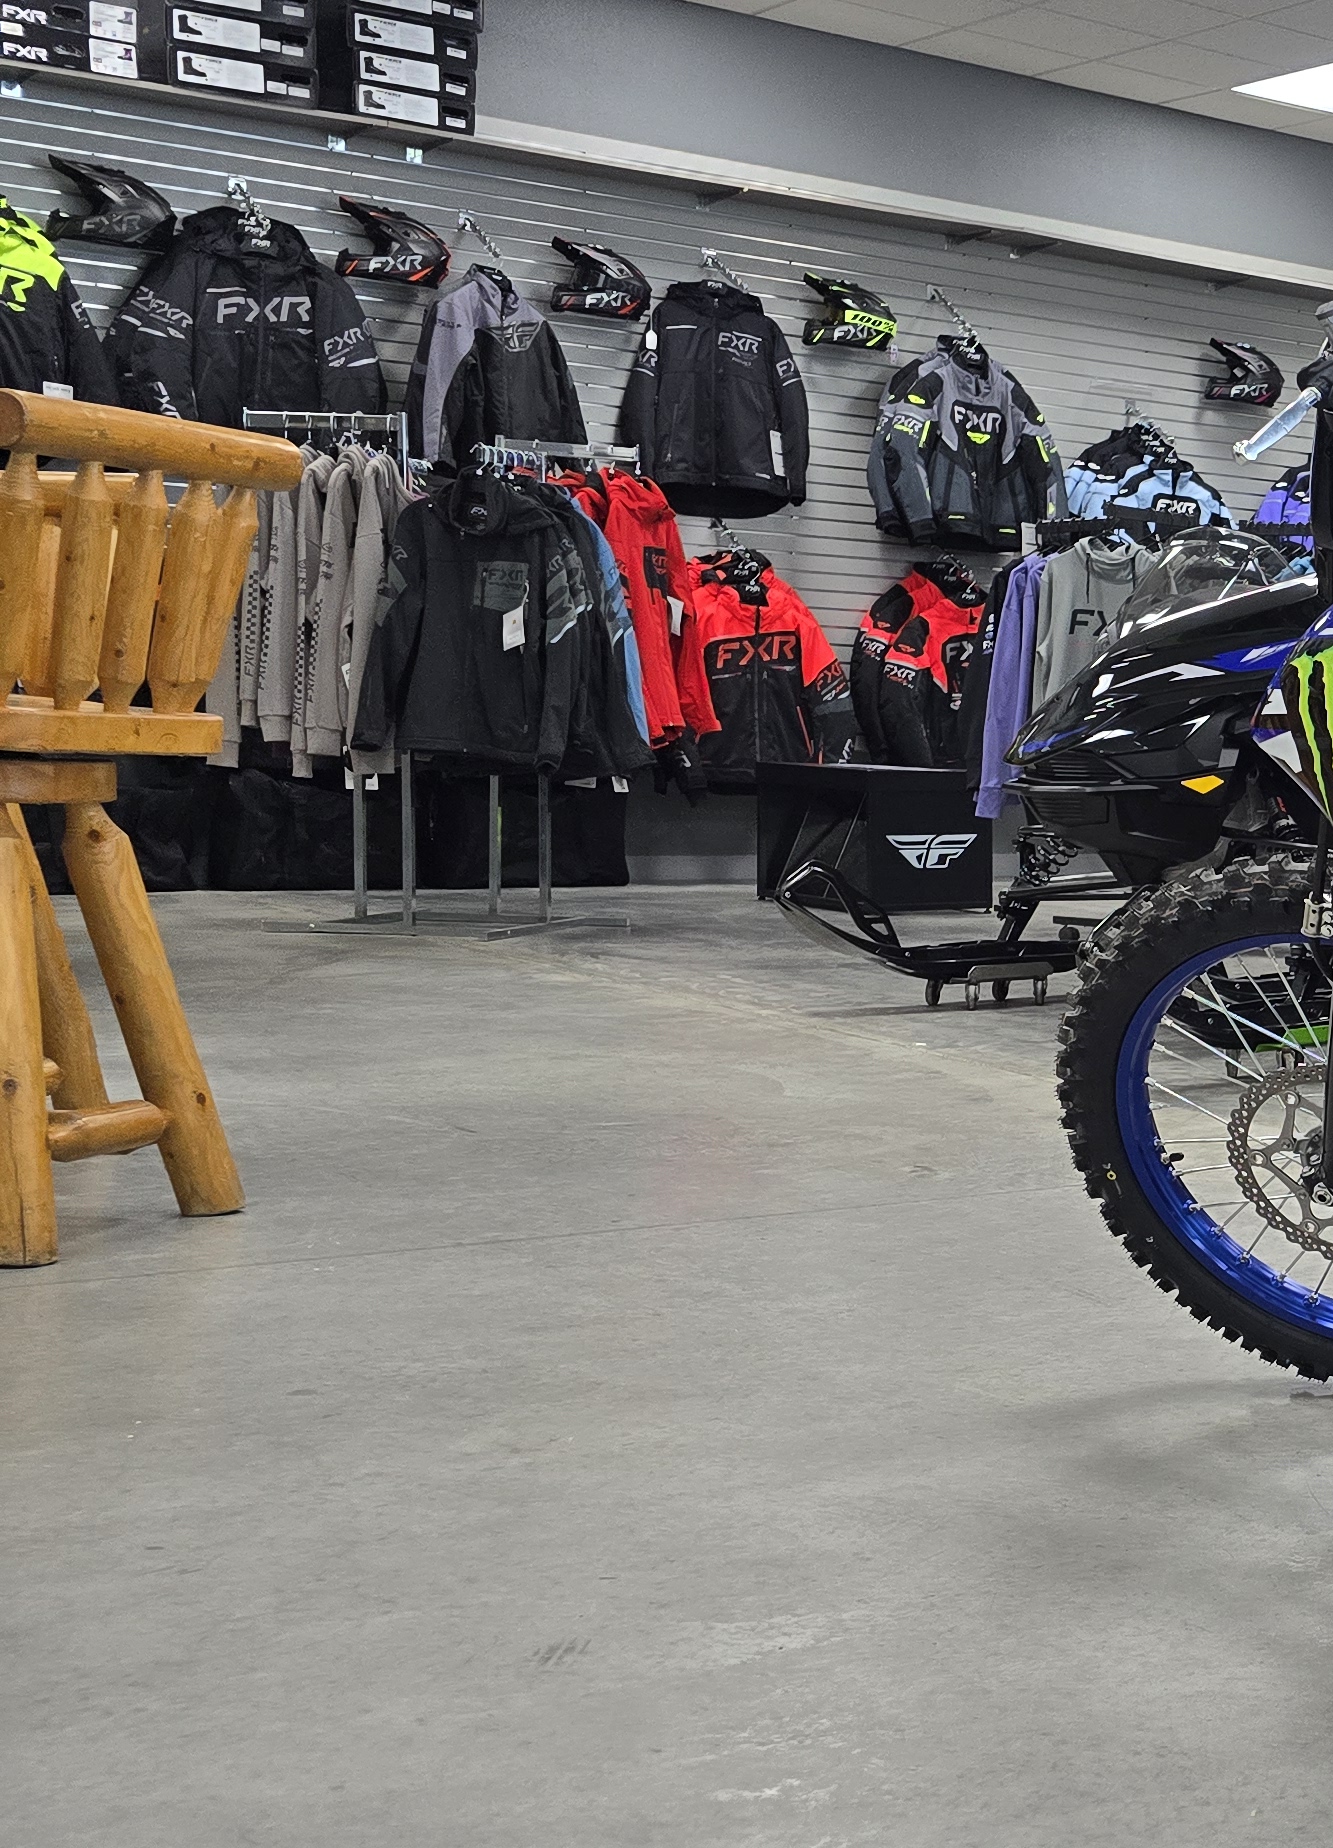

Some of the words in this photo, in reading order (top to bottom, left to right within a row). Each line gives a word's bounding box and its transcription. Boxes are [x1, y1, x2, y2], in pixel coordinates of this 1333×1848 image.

[2, 3, 48, 25] FXR
[2, 41, 48, 62] FXR
[82, 214, 143, 235] FXR
[368, 254, 423, 273] FXR
[217, 296, 311, 324] FXR
[585, 291, 631, 309] FXR
[150, 300, 193, 328] FXR
[850, 313, 896, 332] 100%
[324, 327, 364, 356] FXR
[718, 332, 759, 354] FXR
[776, 360, 797, 377] FX
[1230, 383, 1268, 398] FXR
[892, 414, 923, 433] FXR
[954, 405, 1002, 434] FXR
[1156, 498, 1197, 515] FXR
[487, 569, 524, 581] FXR
[1069, 608, 1107, 636] FX
[716, 635, 797, 669] FXR
[861, 640, 886, 654] FXR
[244, 644, 256, 678] FXR
[883, 662, 916, 681] FXR
[292, 693, 303, 727] FXR
